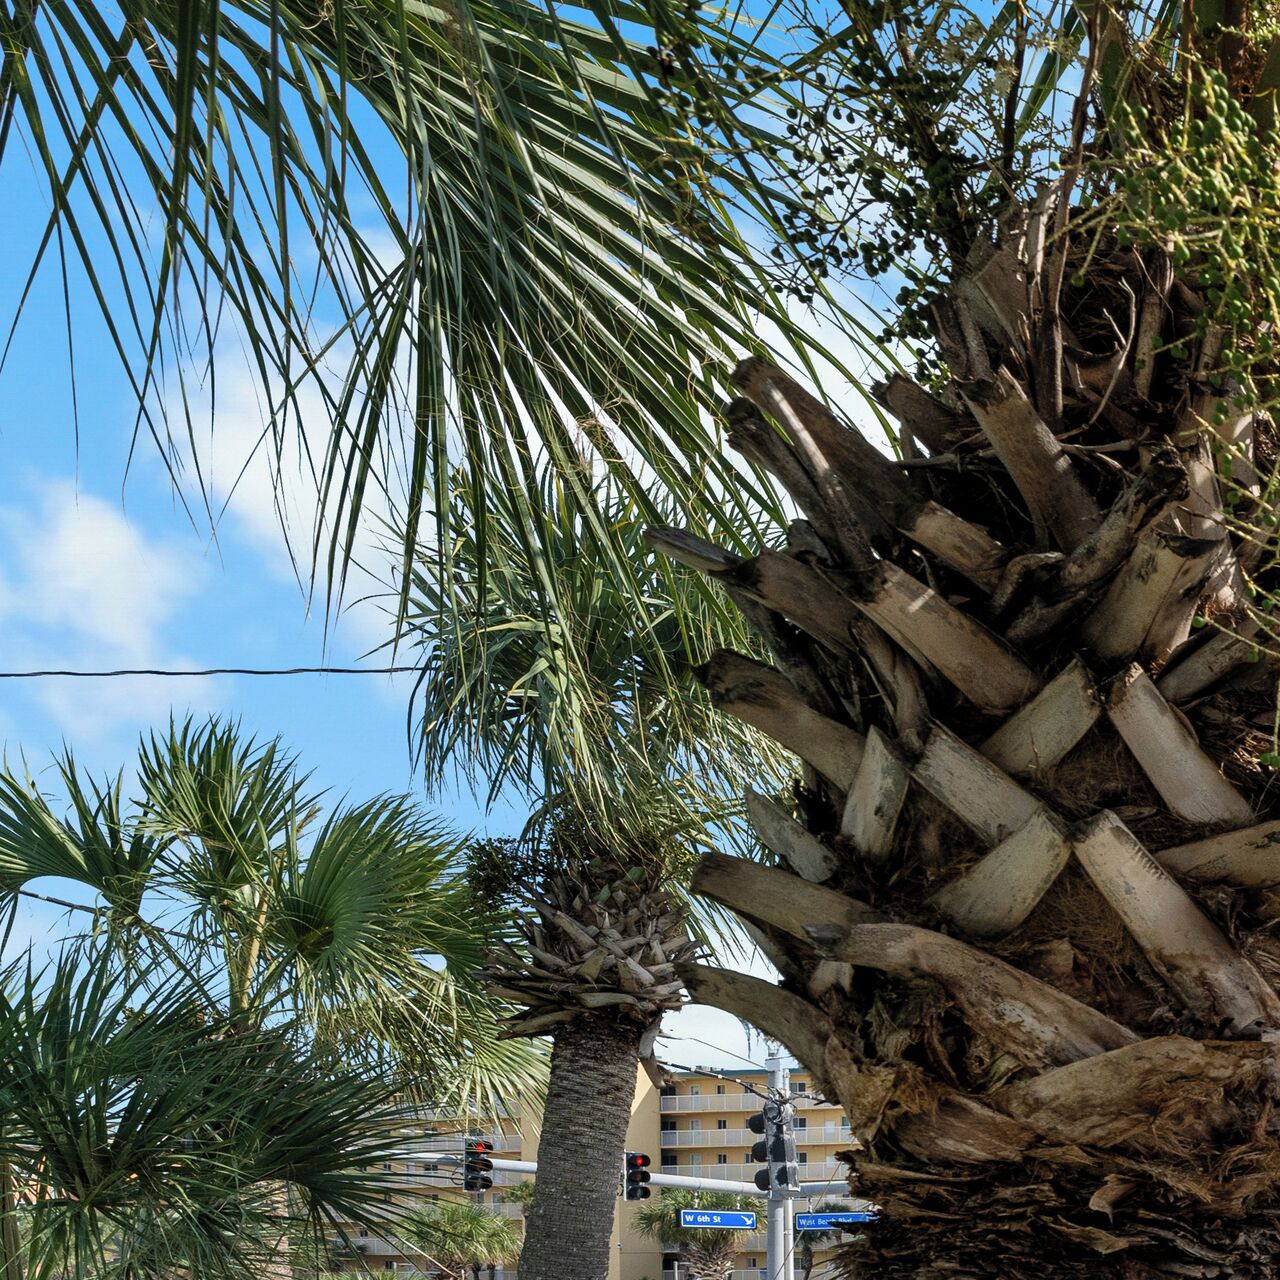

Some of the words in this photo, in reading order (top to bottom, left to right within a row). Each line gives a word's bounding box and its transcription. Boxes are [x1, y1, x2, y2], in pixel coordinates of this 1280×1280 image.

[685, 1214, 694, 1222] W
[697, 1214, 711, 1222] 6th
[713, 1215, 722, 1223] St
[799, 1218, 815, 1226] West
[818, 1217, 836, 1225] Beah
